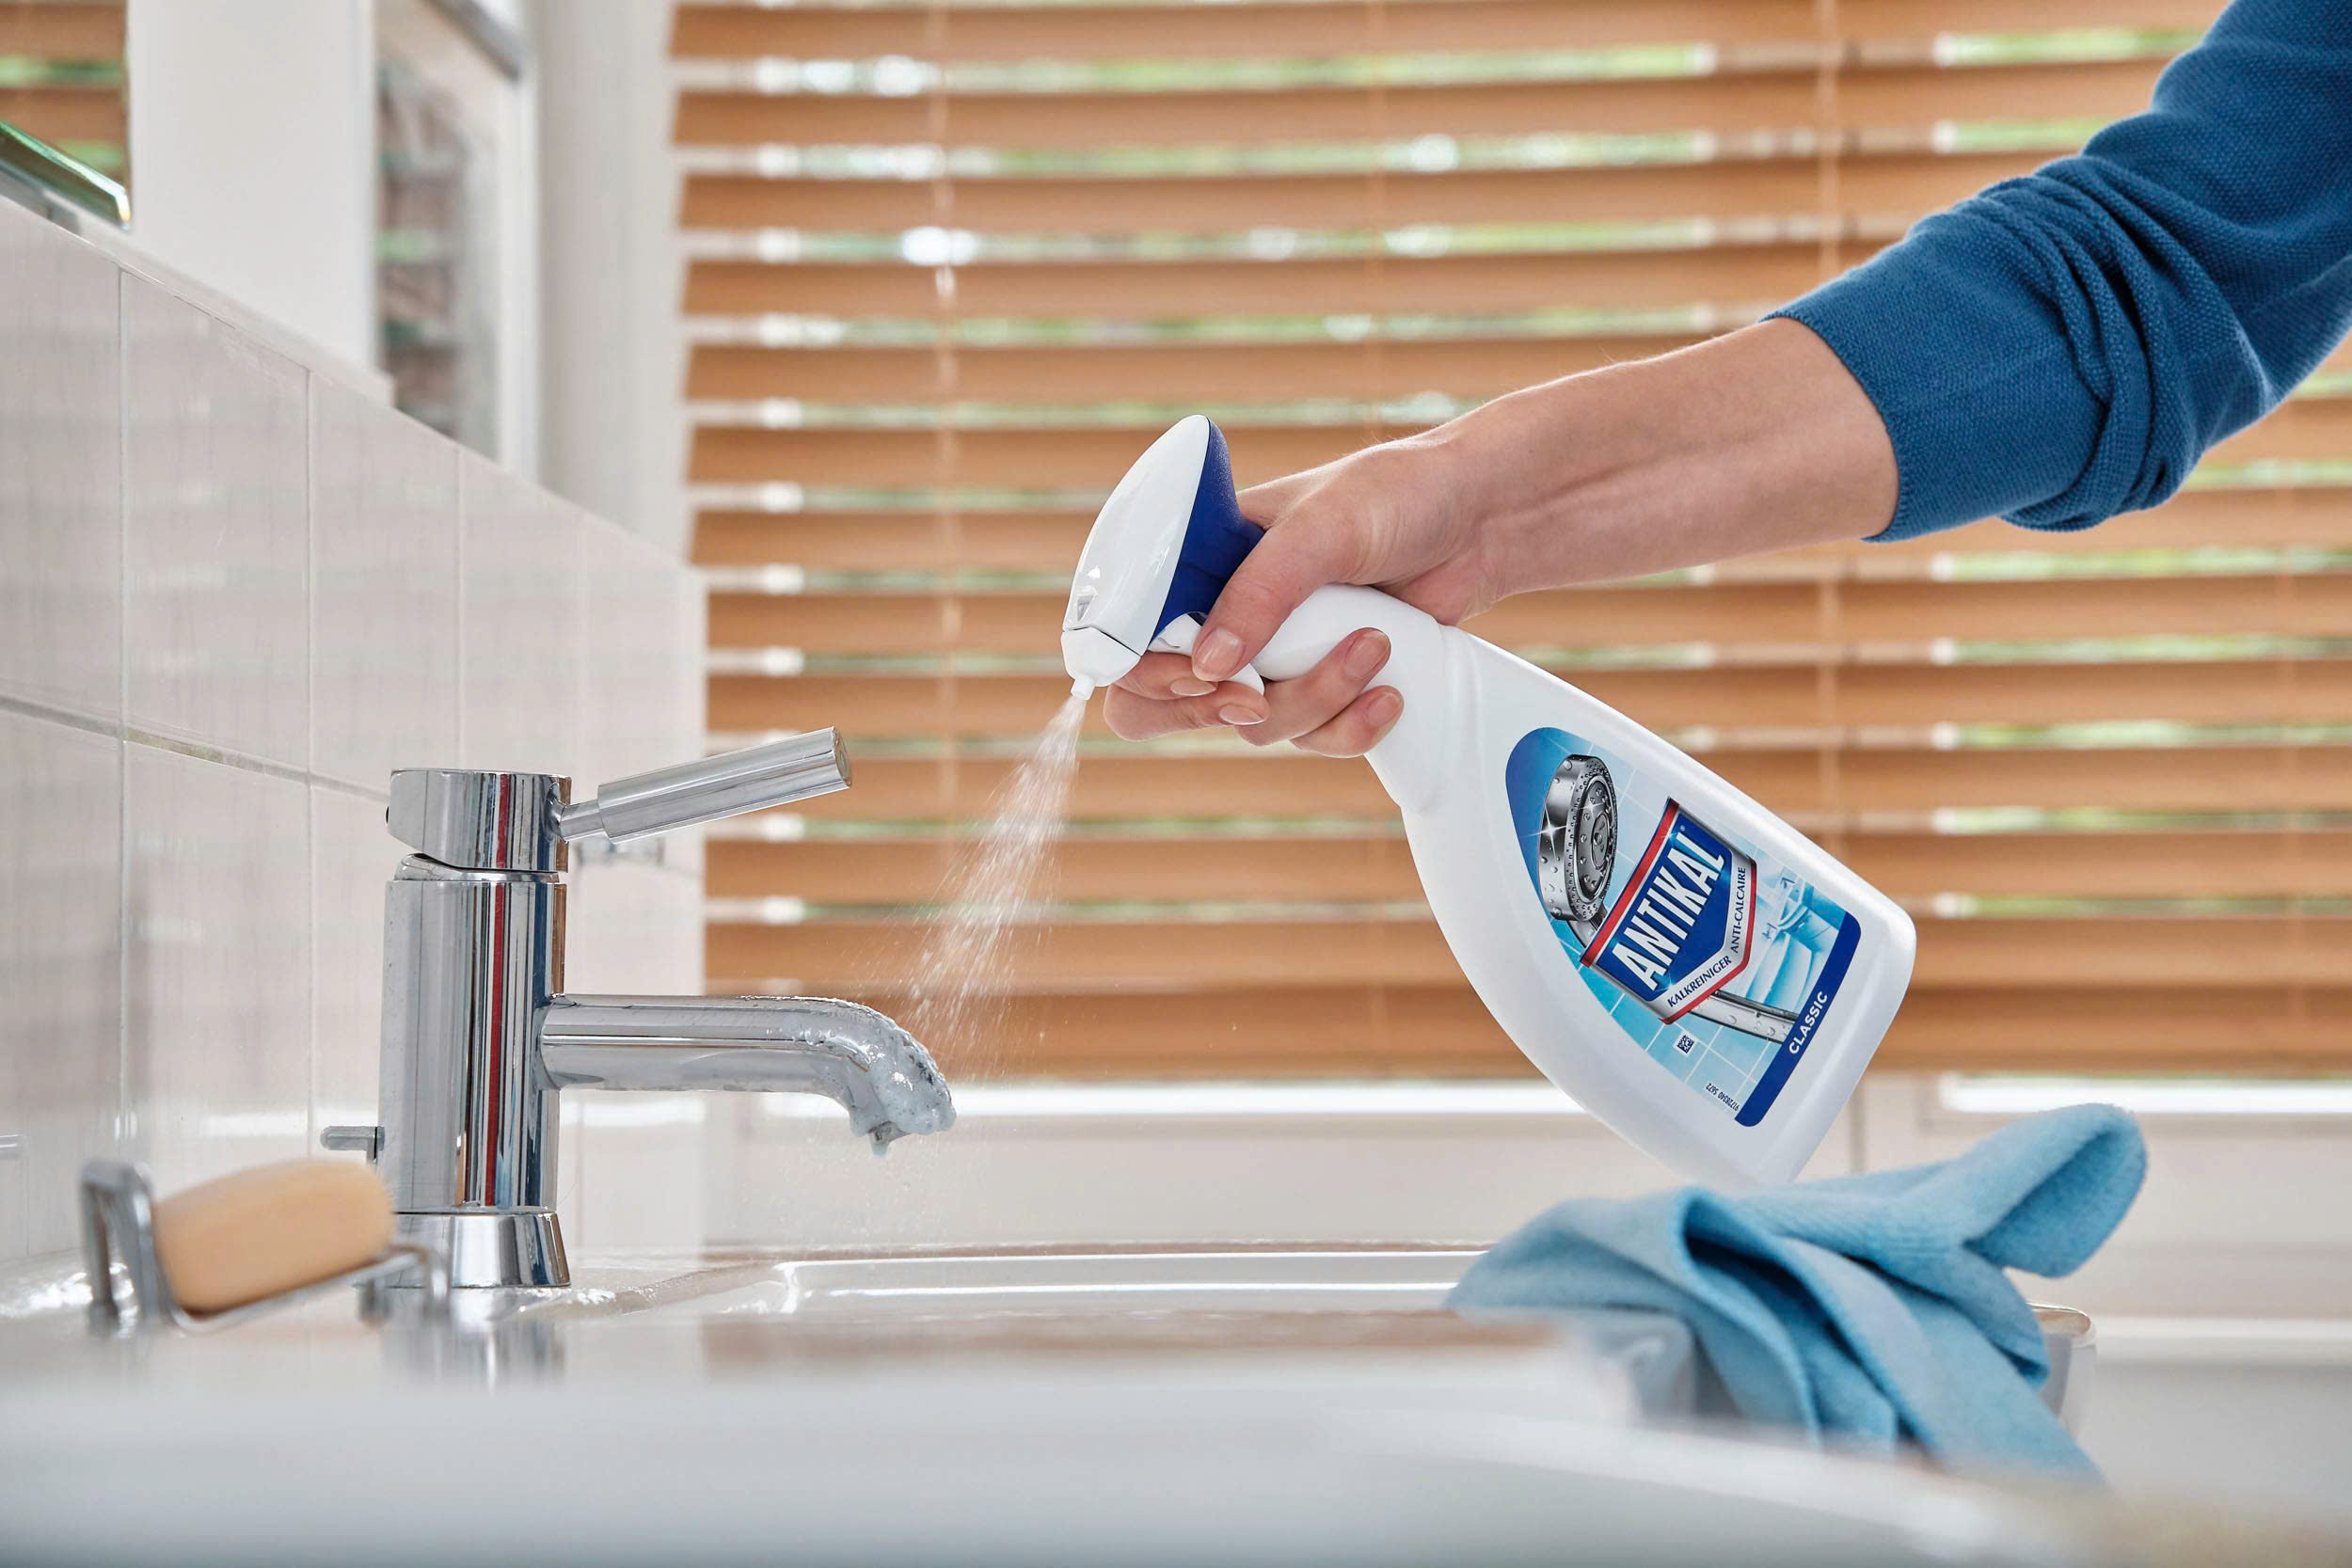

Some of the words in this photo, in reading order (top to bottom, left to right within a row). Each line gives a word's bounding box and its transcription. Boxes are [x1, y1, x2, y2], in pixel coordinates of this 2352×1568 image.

[1612, 832, 1725, 991] ANTIKAL
[1731, 866, 1746, 954] ANTI-CALCAIRE
[1667, 955, 1732, 1007] KALKREINIGER
[1788, 990, 1828, 1054] CLASSIC
